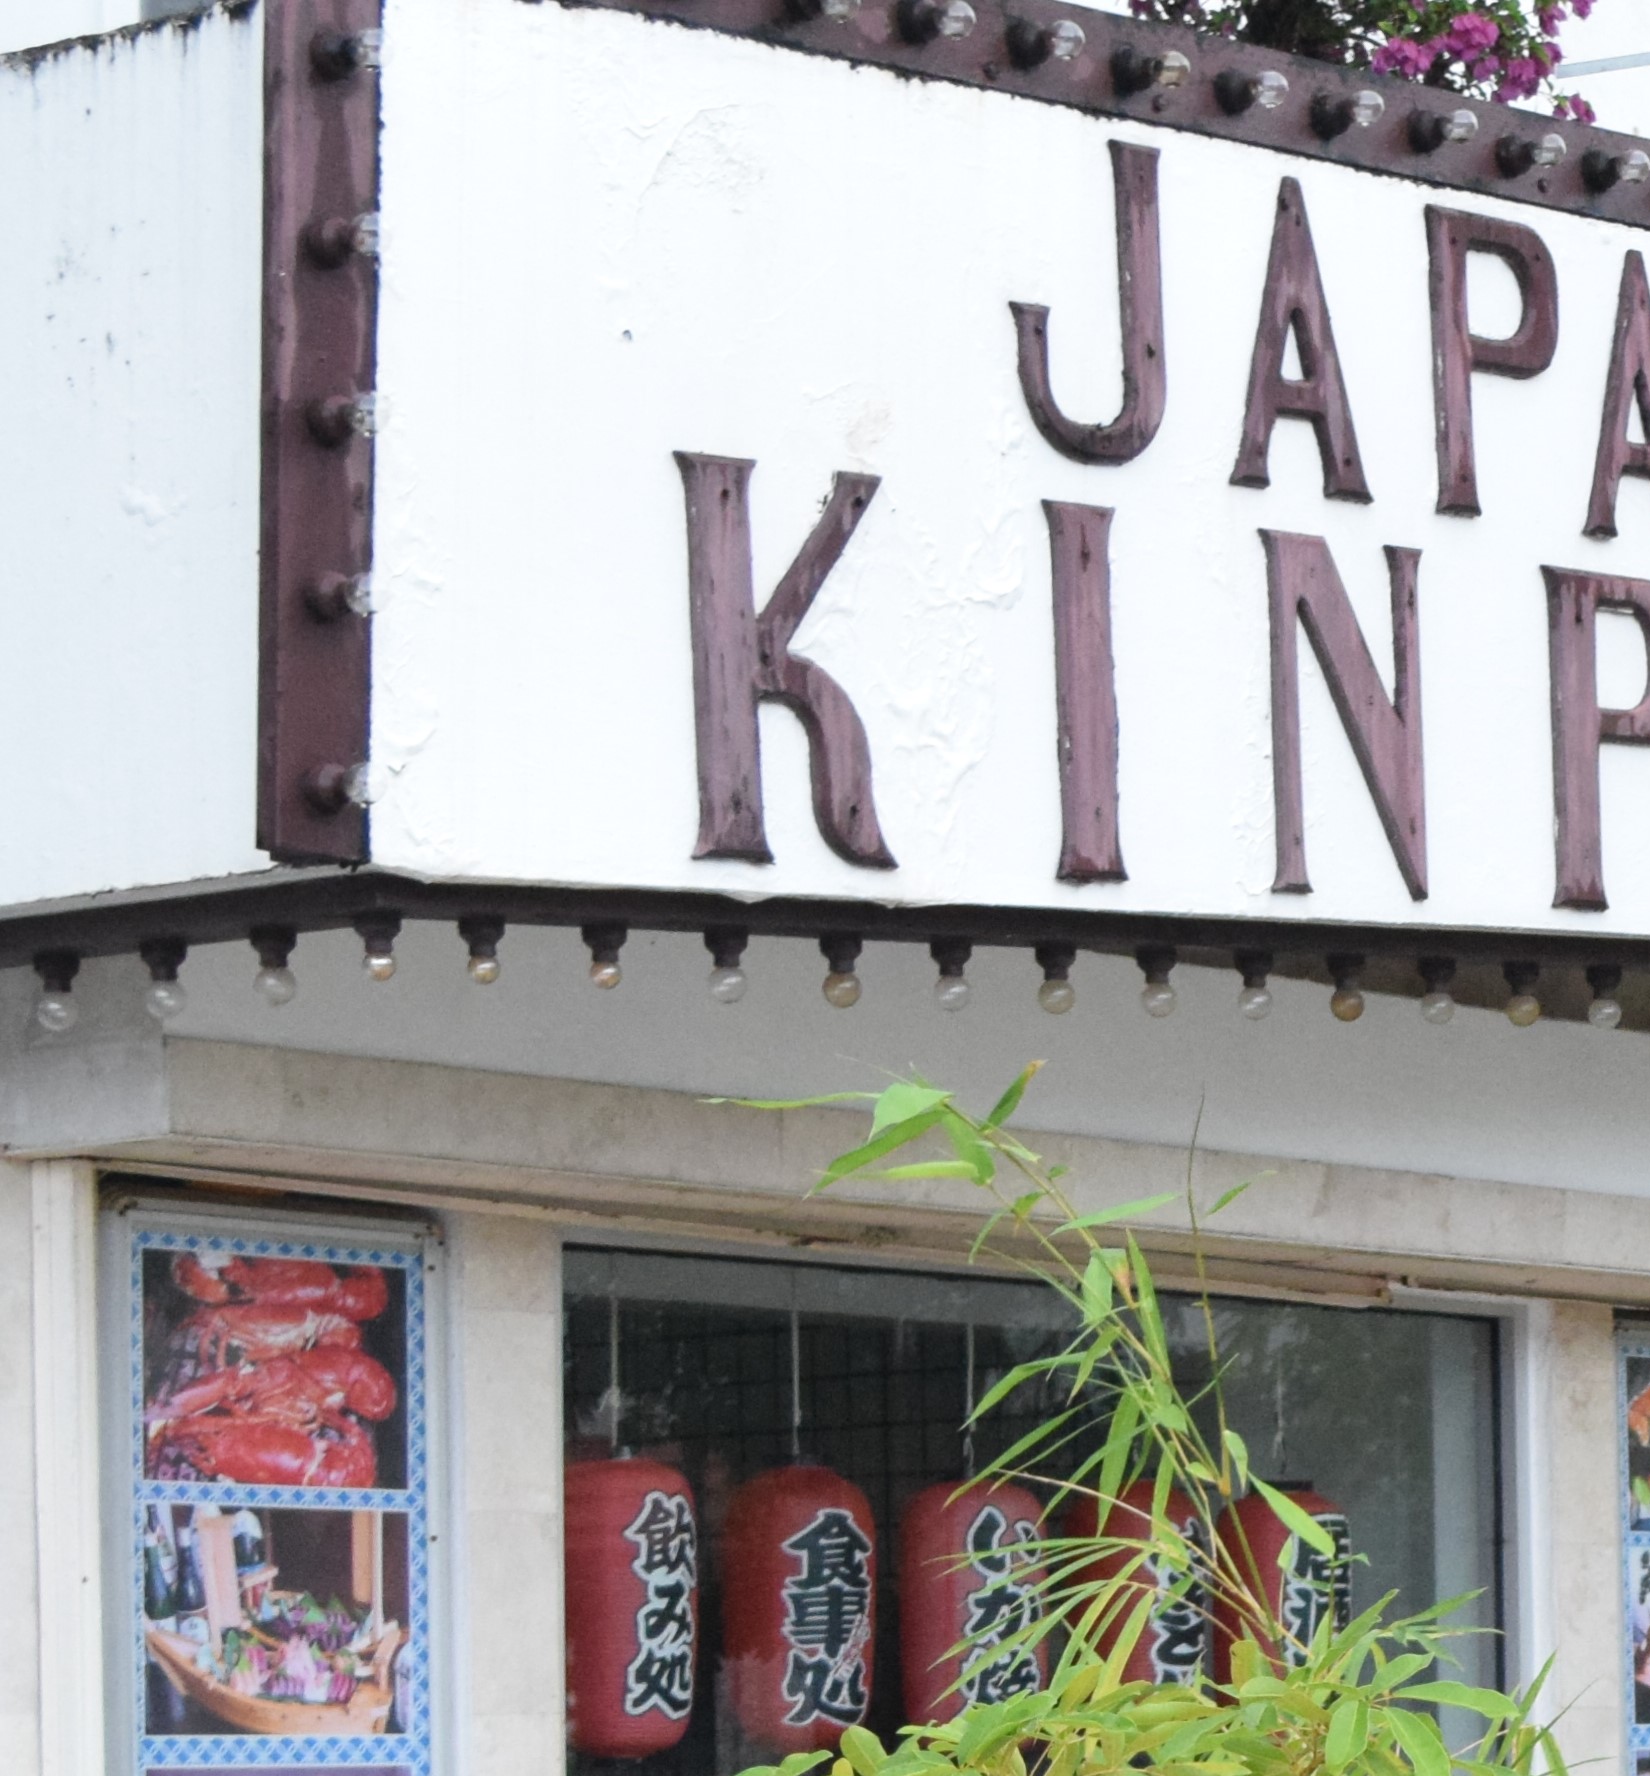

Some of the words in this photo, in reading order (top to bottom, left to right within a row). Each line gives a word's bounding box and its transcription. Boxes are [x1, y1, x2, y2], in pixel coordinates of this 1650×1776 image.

[623, 1491, 697, 1720] 飲み処
[781, 1508, 872, 1727] 食事処
